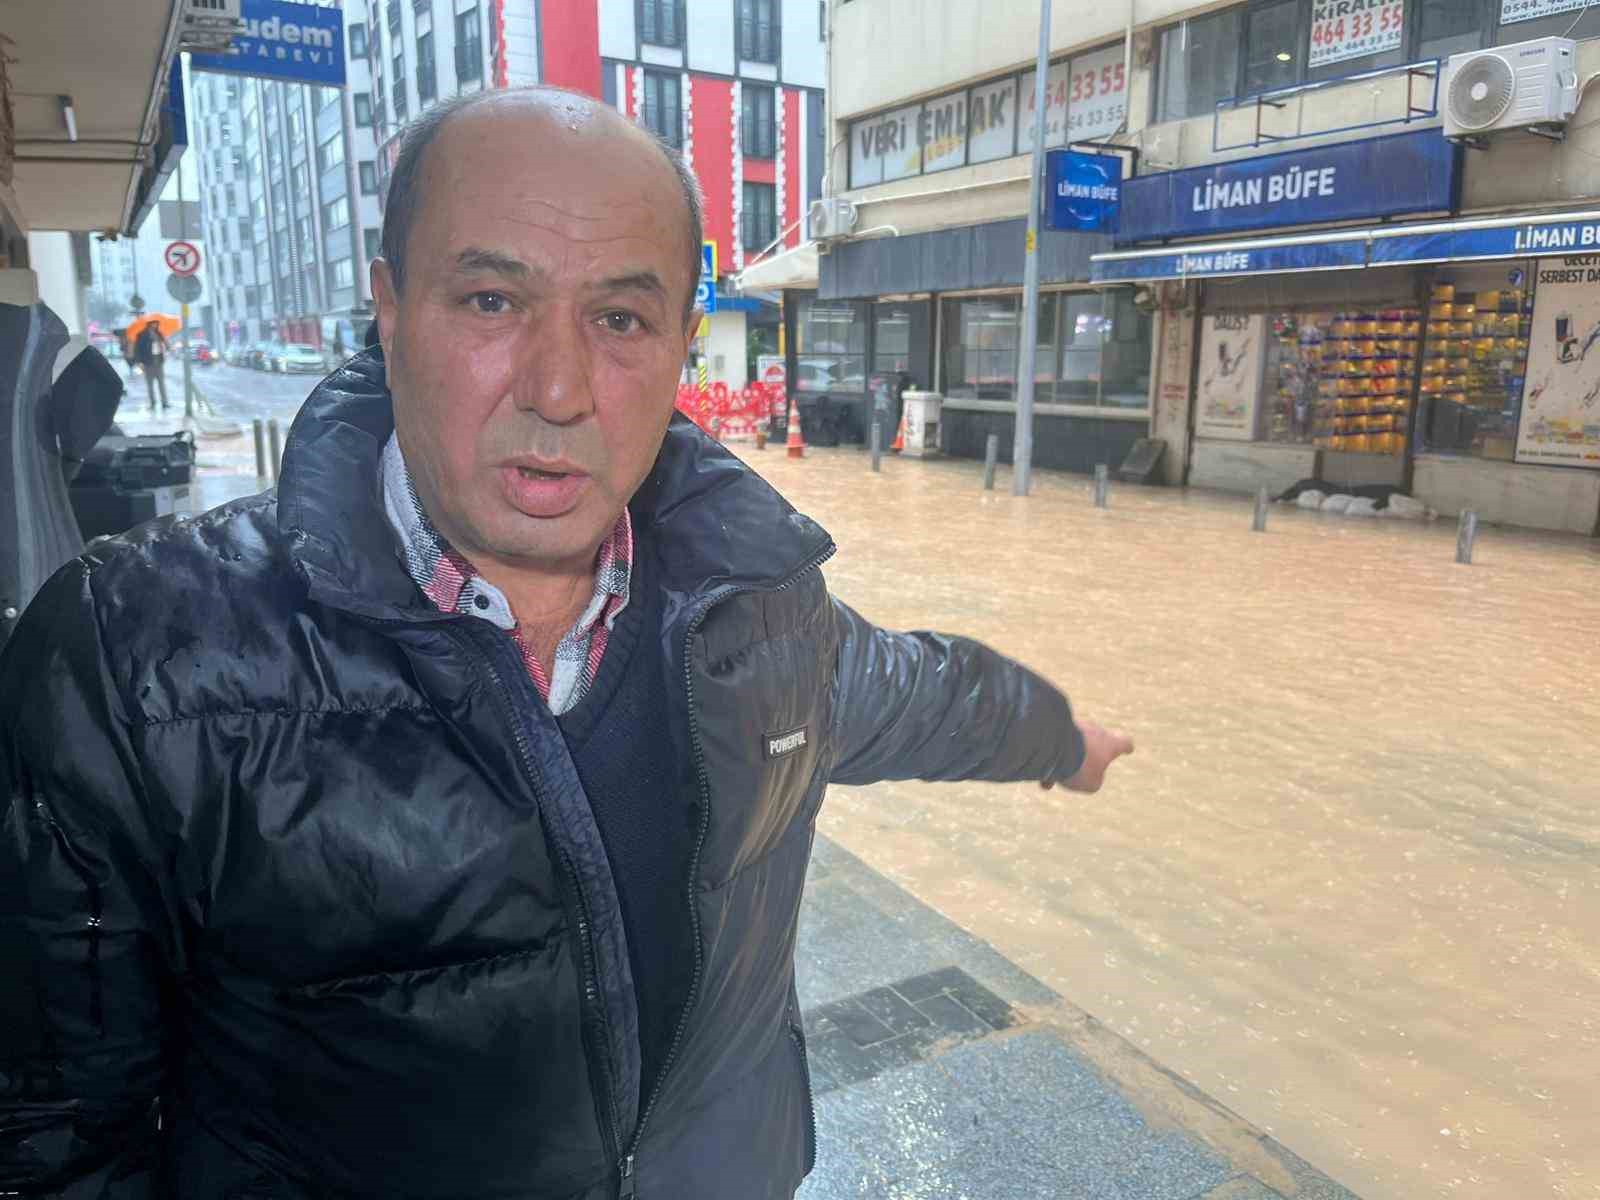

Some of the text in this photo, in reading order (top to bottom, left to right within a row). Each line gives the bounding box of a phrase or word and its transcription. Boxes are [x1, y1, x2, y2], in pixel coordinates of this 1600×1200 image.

[238, 16, 333, 47] udem
[1312, 4, 1402, 46] 464 33 55
[1071, 70, 1095, 102] 33
[1100, 63, 1125, 95] 55
[1057, 180, 1118, 201] LİMAN BÜFE
[1192, 166, 1336, 212] LİMAN BÜFE
[1515, 226, 1577, 249] LİMAN
[1175, 252, 1249, 273] LİMAN BÜFE
[1539, 269, 1584, 284] SERBEST
